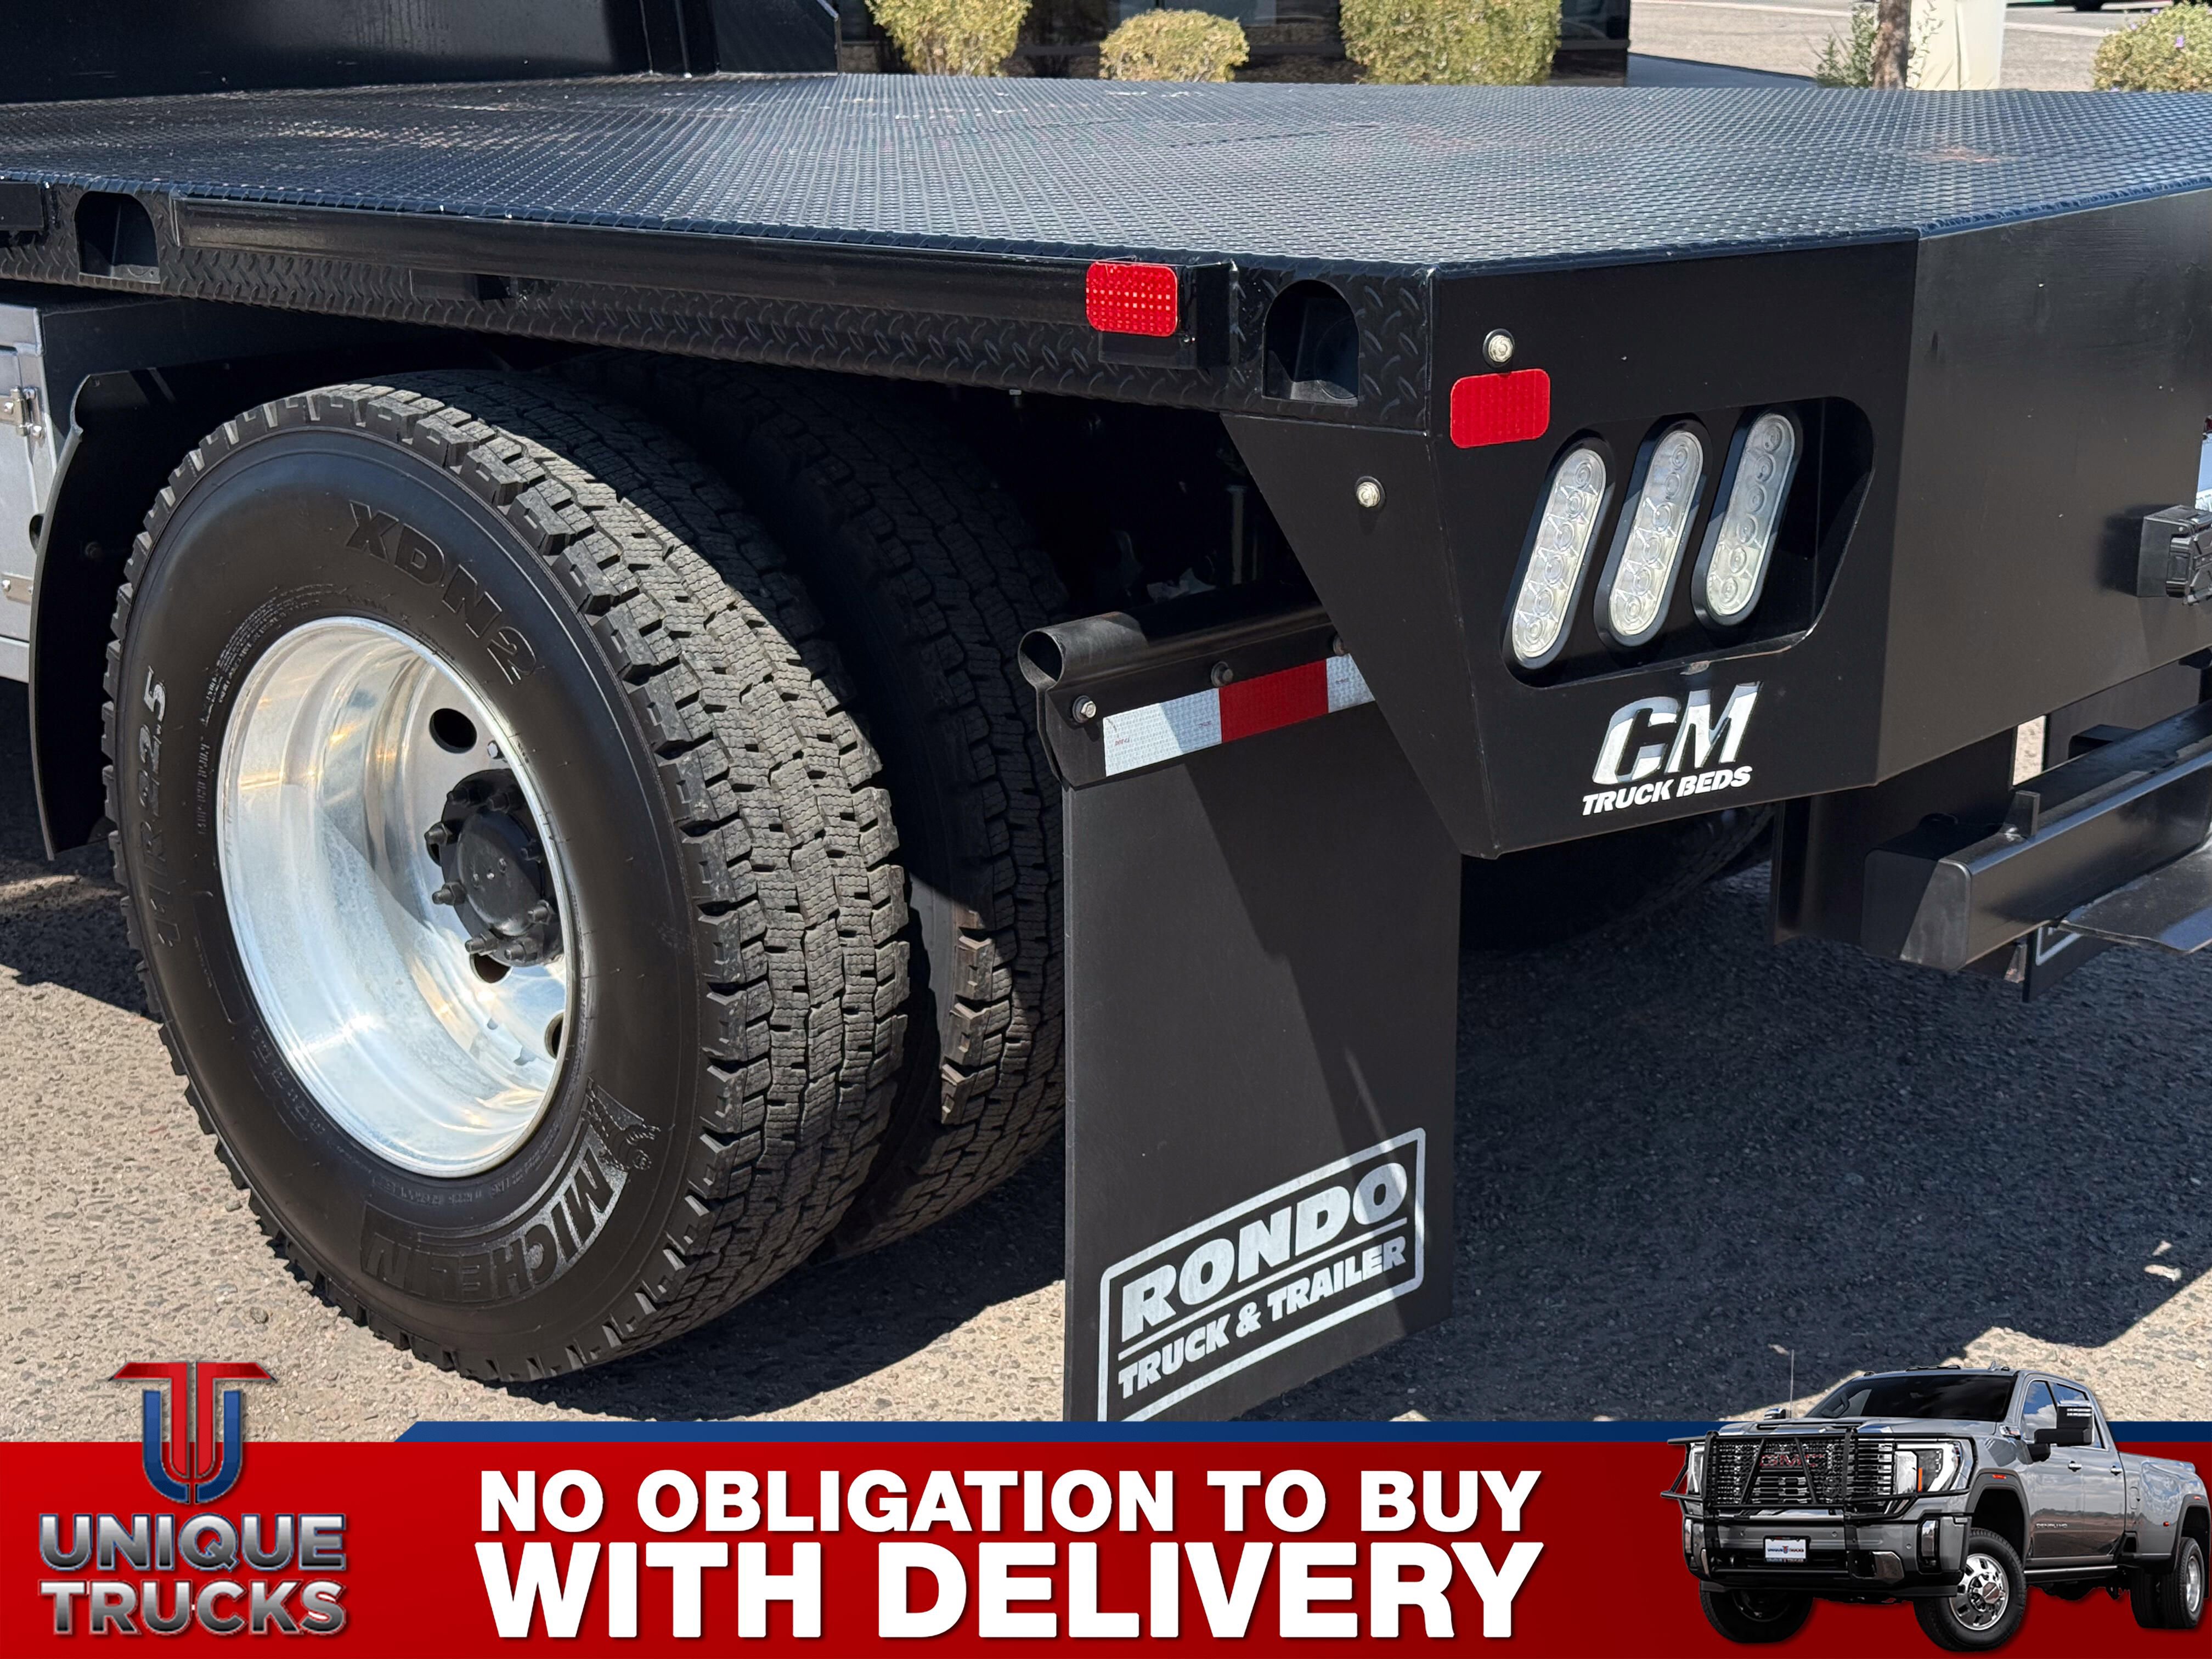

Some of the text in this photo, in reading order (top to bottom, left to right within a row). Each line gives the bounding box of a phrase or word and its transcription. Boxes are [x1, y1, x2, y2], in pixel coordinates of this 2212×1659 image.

[345, 501, 537, 686] XDN2
[1582, 766, 1753, 816] TRUCK BEDS
[1592, 681, 1763, 785] CM
[364, 1141, 616, 1302] MICHELIN
[1121, 1163, 1408, 1342] RONDO
[1118, 1237, 1406, 1398] TRUCK & TRAILER
